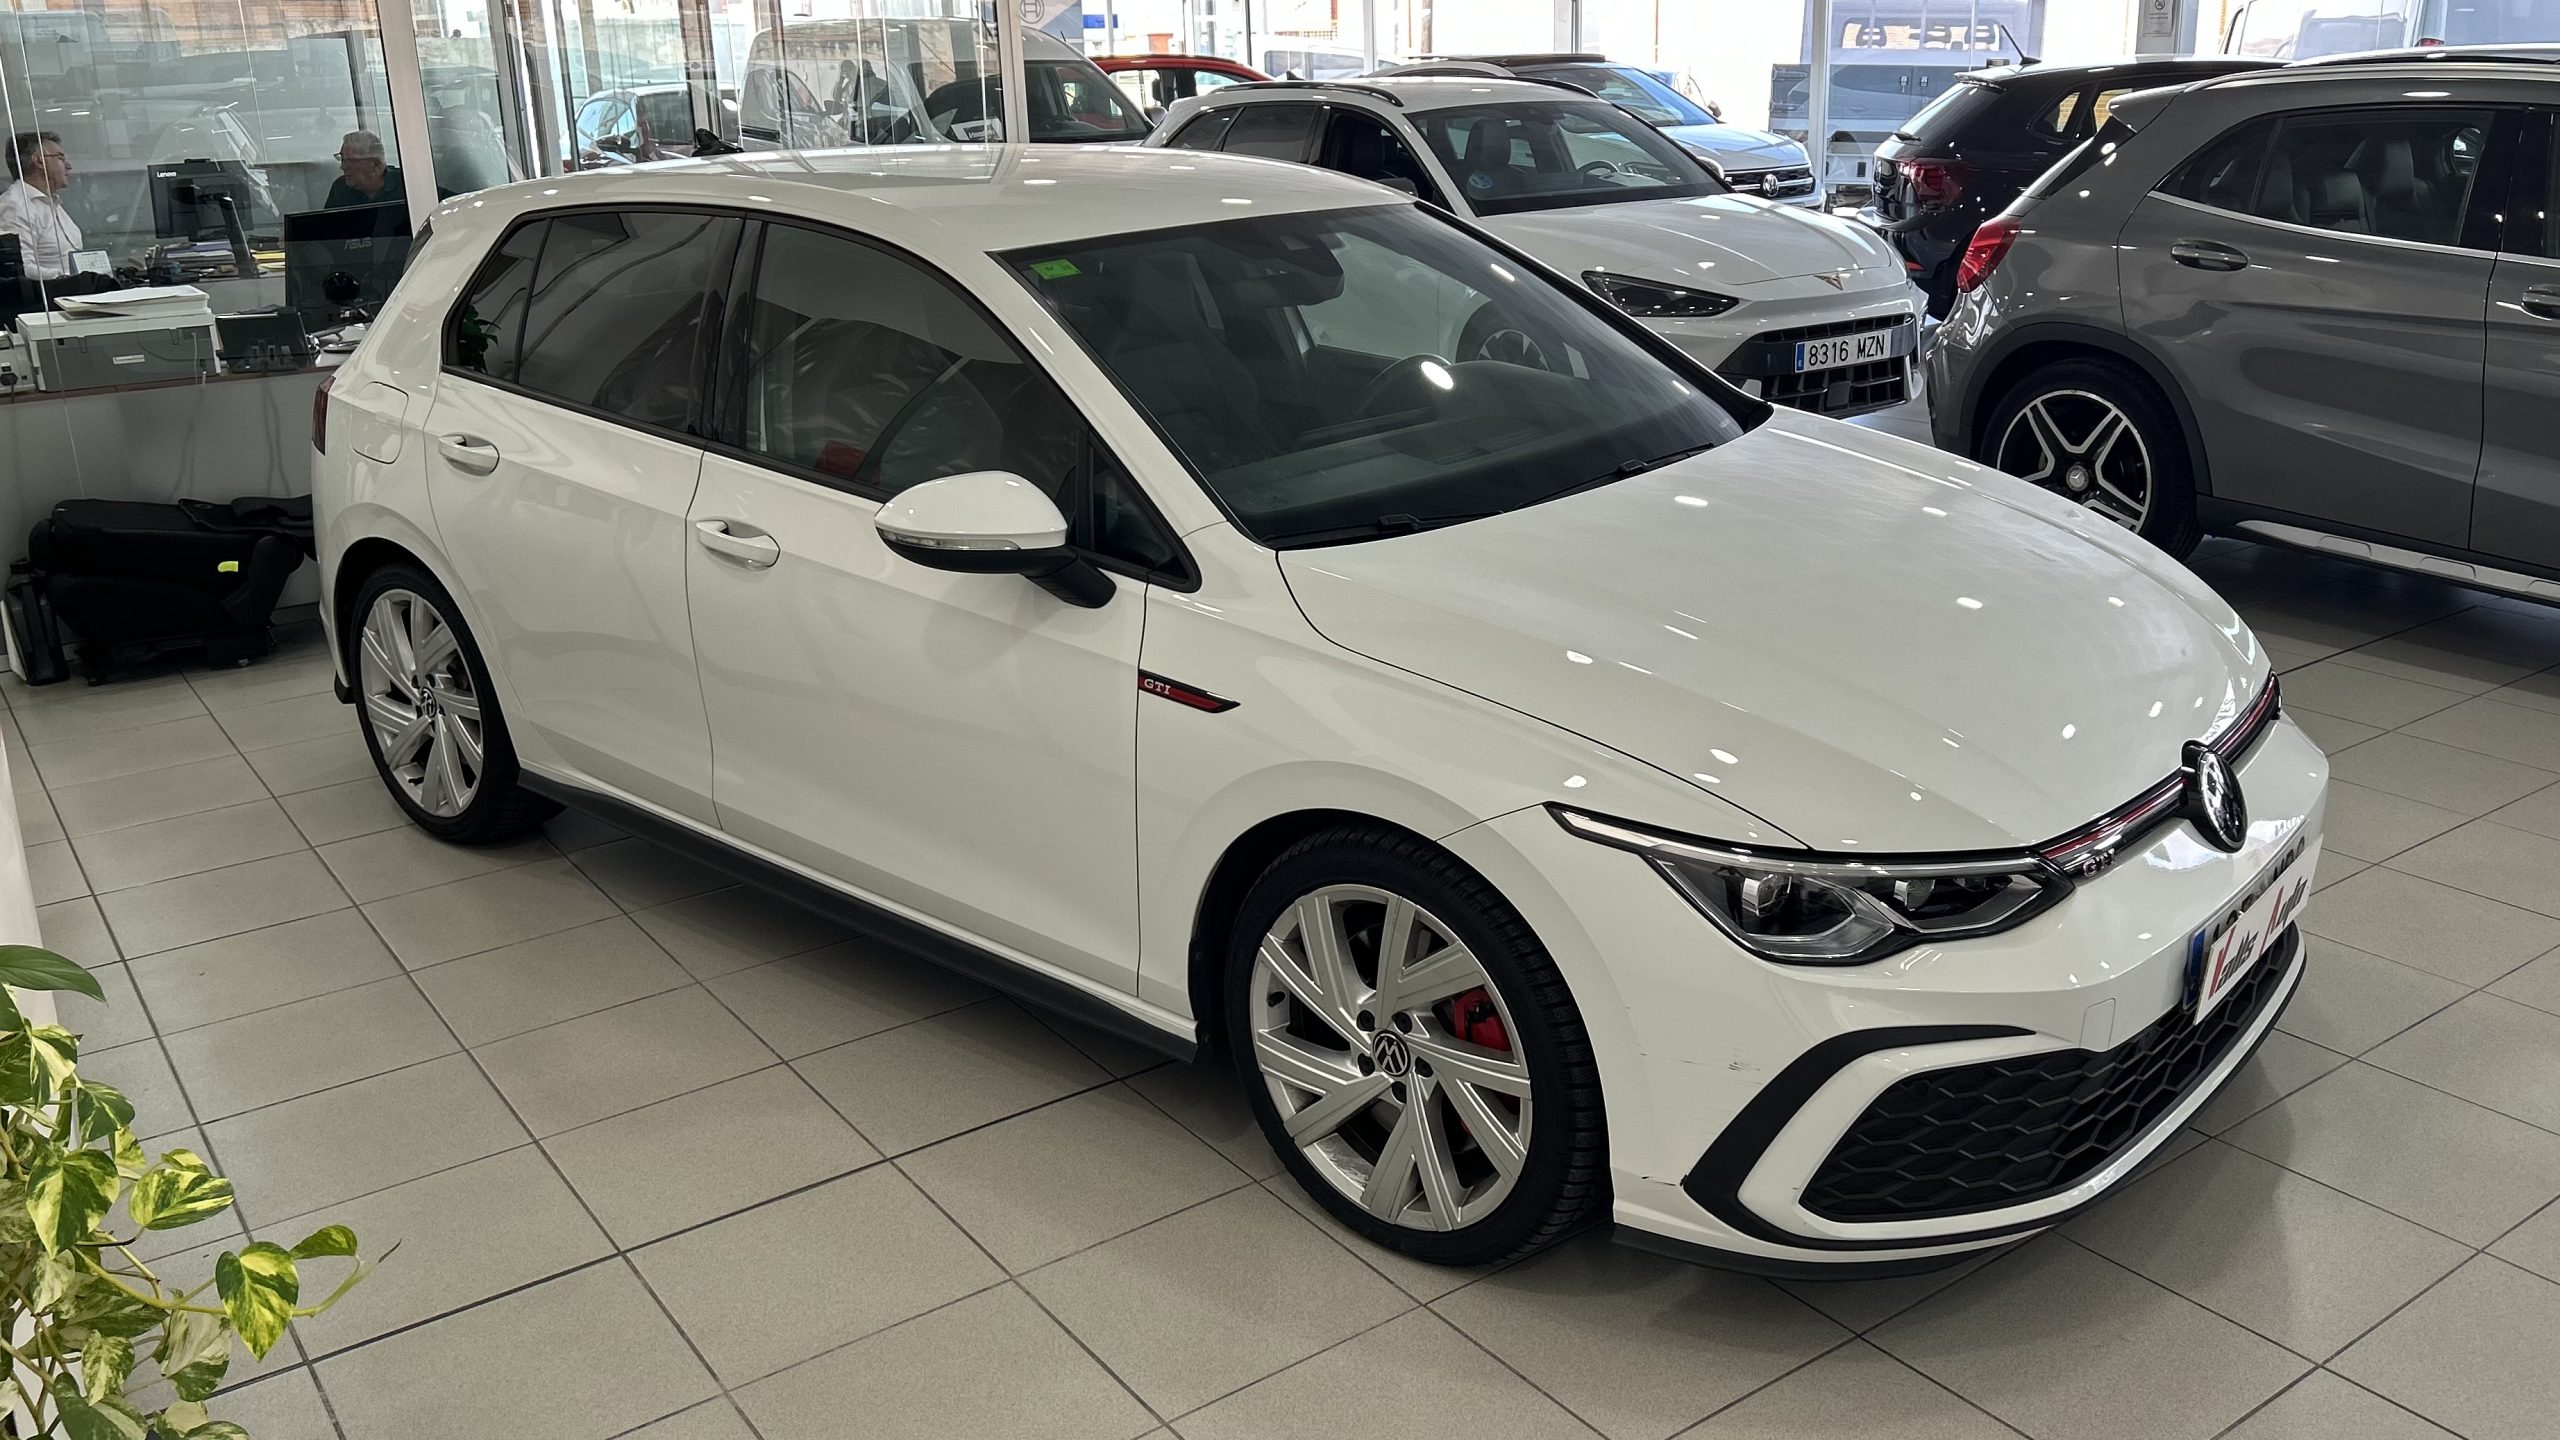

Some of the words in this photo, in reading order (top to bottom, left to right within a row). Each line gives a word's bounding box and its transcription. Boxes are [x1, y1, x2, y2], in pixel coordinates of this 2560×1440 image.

[344, 236, 373, 250] ASUS
[1809, 340, 1849, 367] 8316
[1857, 334, 1885, 359] MZN
[1144, 678, 1172, 695] GTI
